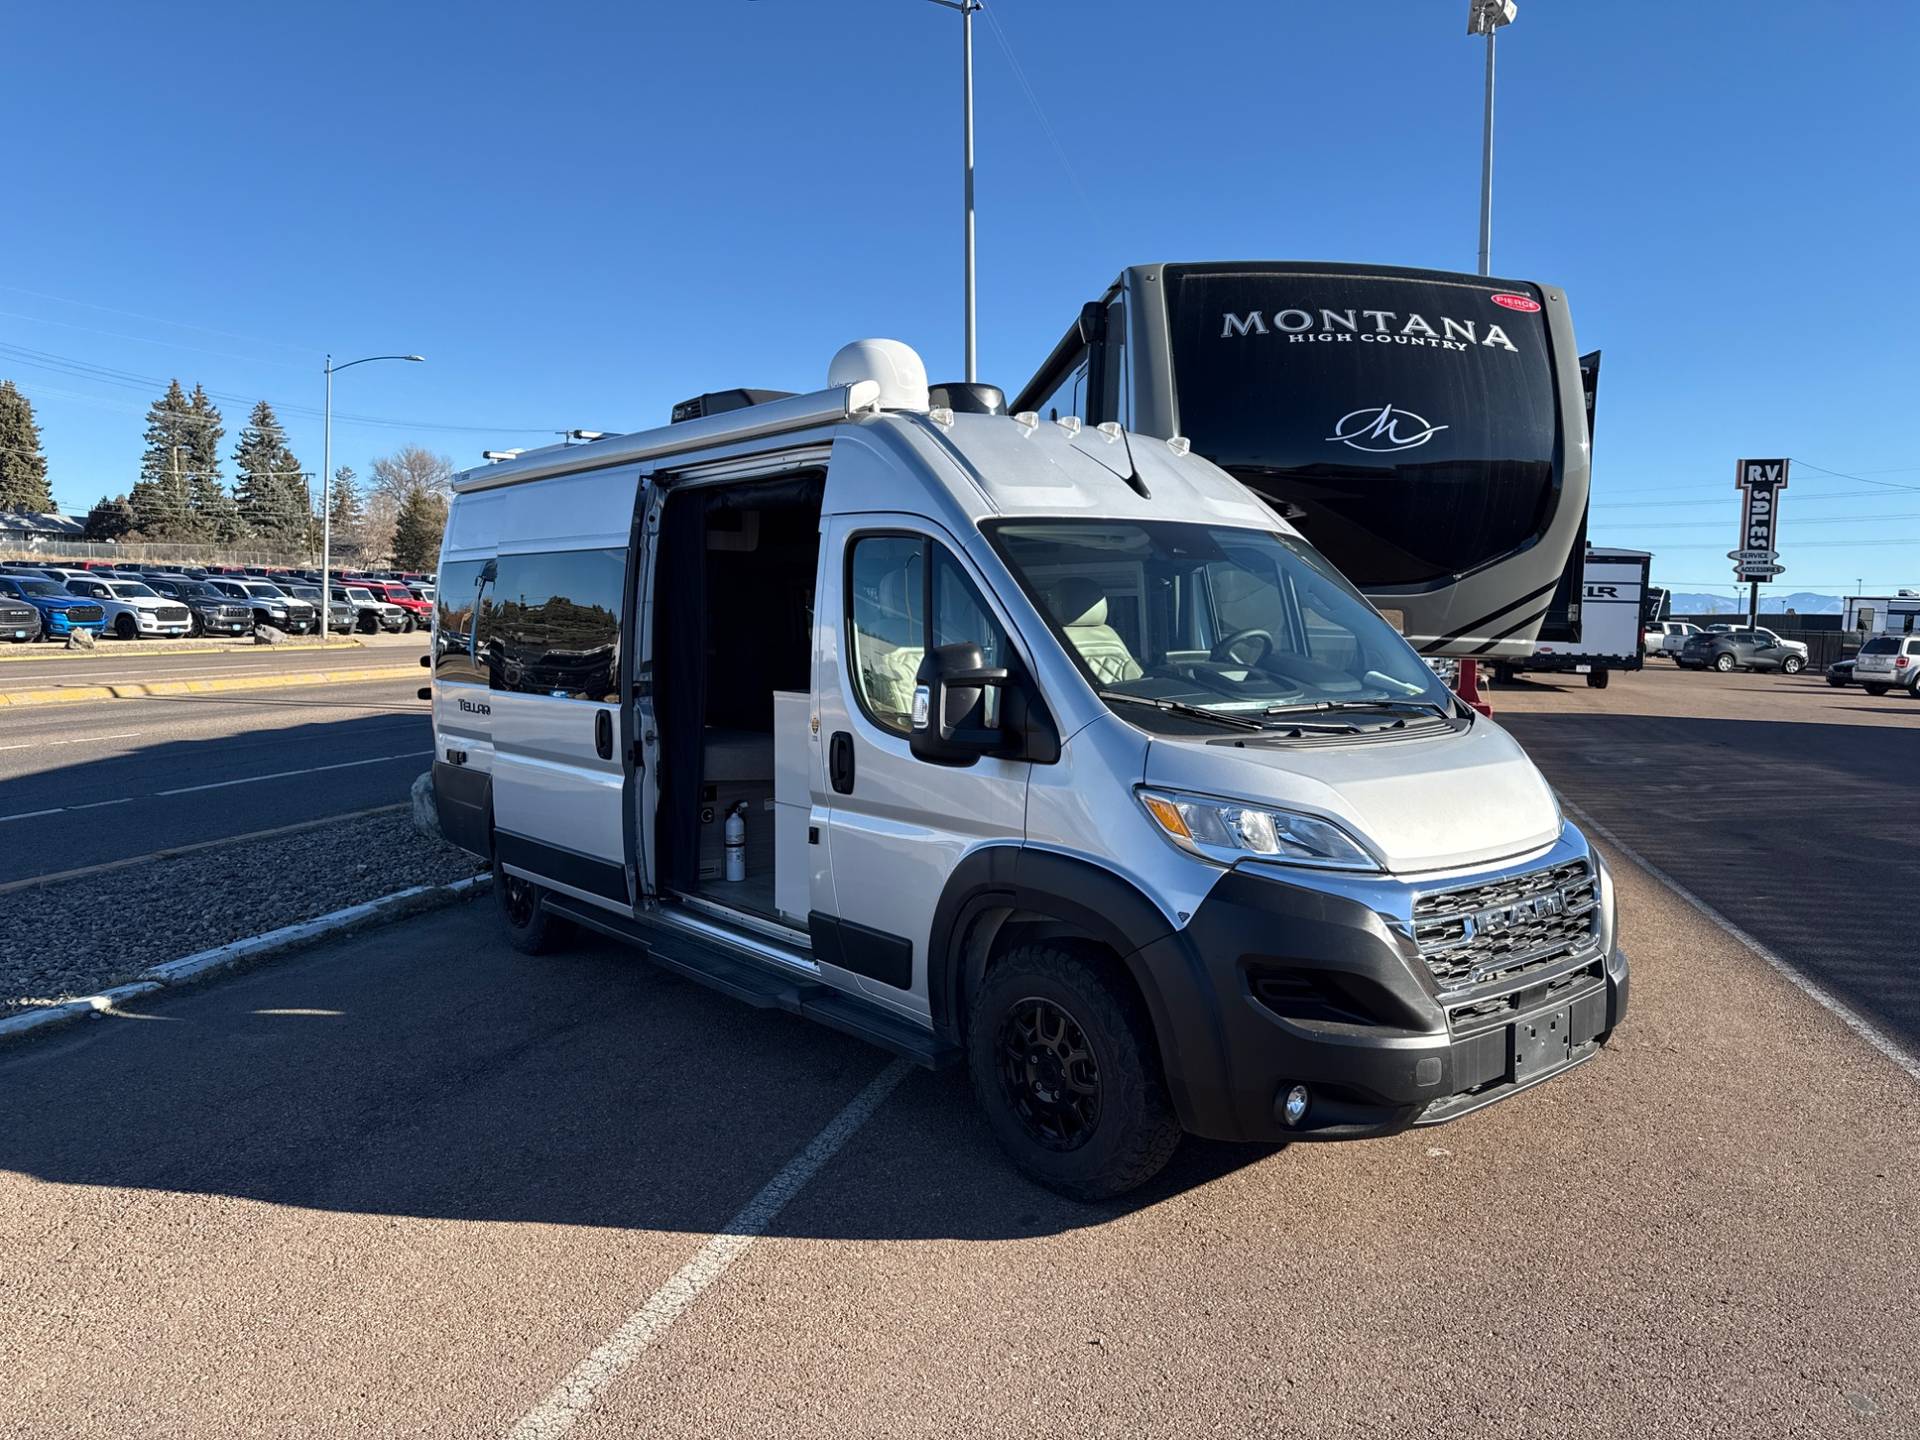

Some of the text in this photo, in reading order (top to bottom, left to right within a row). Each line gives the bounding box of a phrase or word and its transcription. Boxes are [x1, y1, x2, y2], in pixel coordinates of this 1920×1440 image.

[1496, 296, 1536, 308] PIERCE
[1220, 309, 1519, 352] MONTANA
[1288, 333, 1468, 351] HIGH COUNTRY
[1750, 490, 1771, 548] SALES
[457, 698, 491, 716] TELLAR
[1474, 892, 1561, 935] RAM
